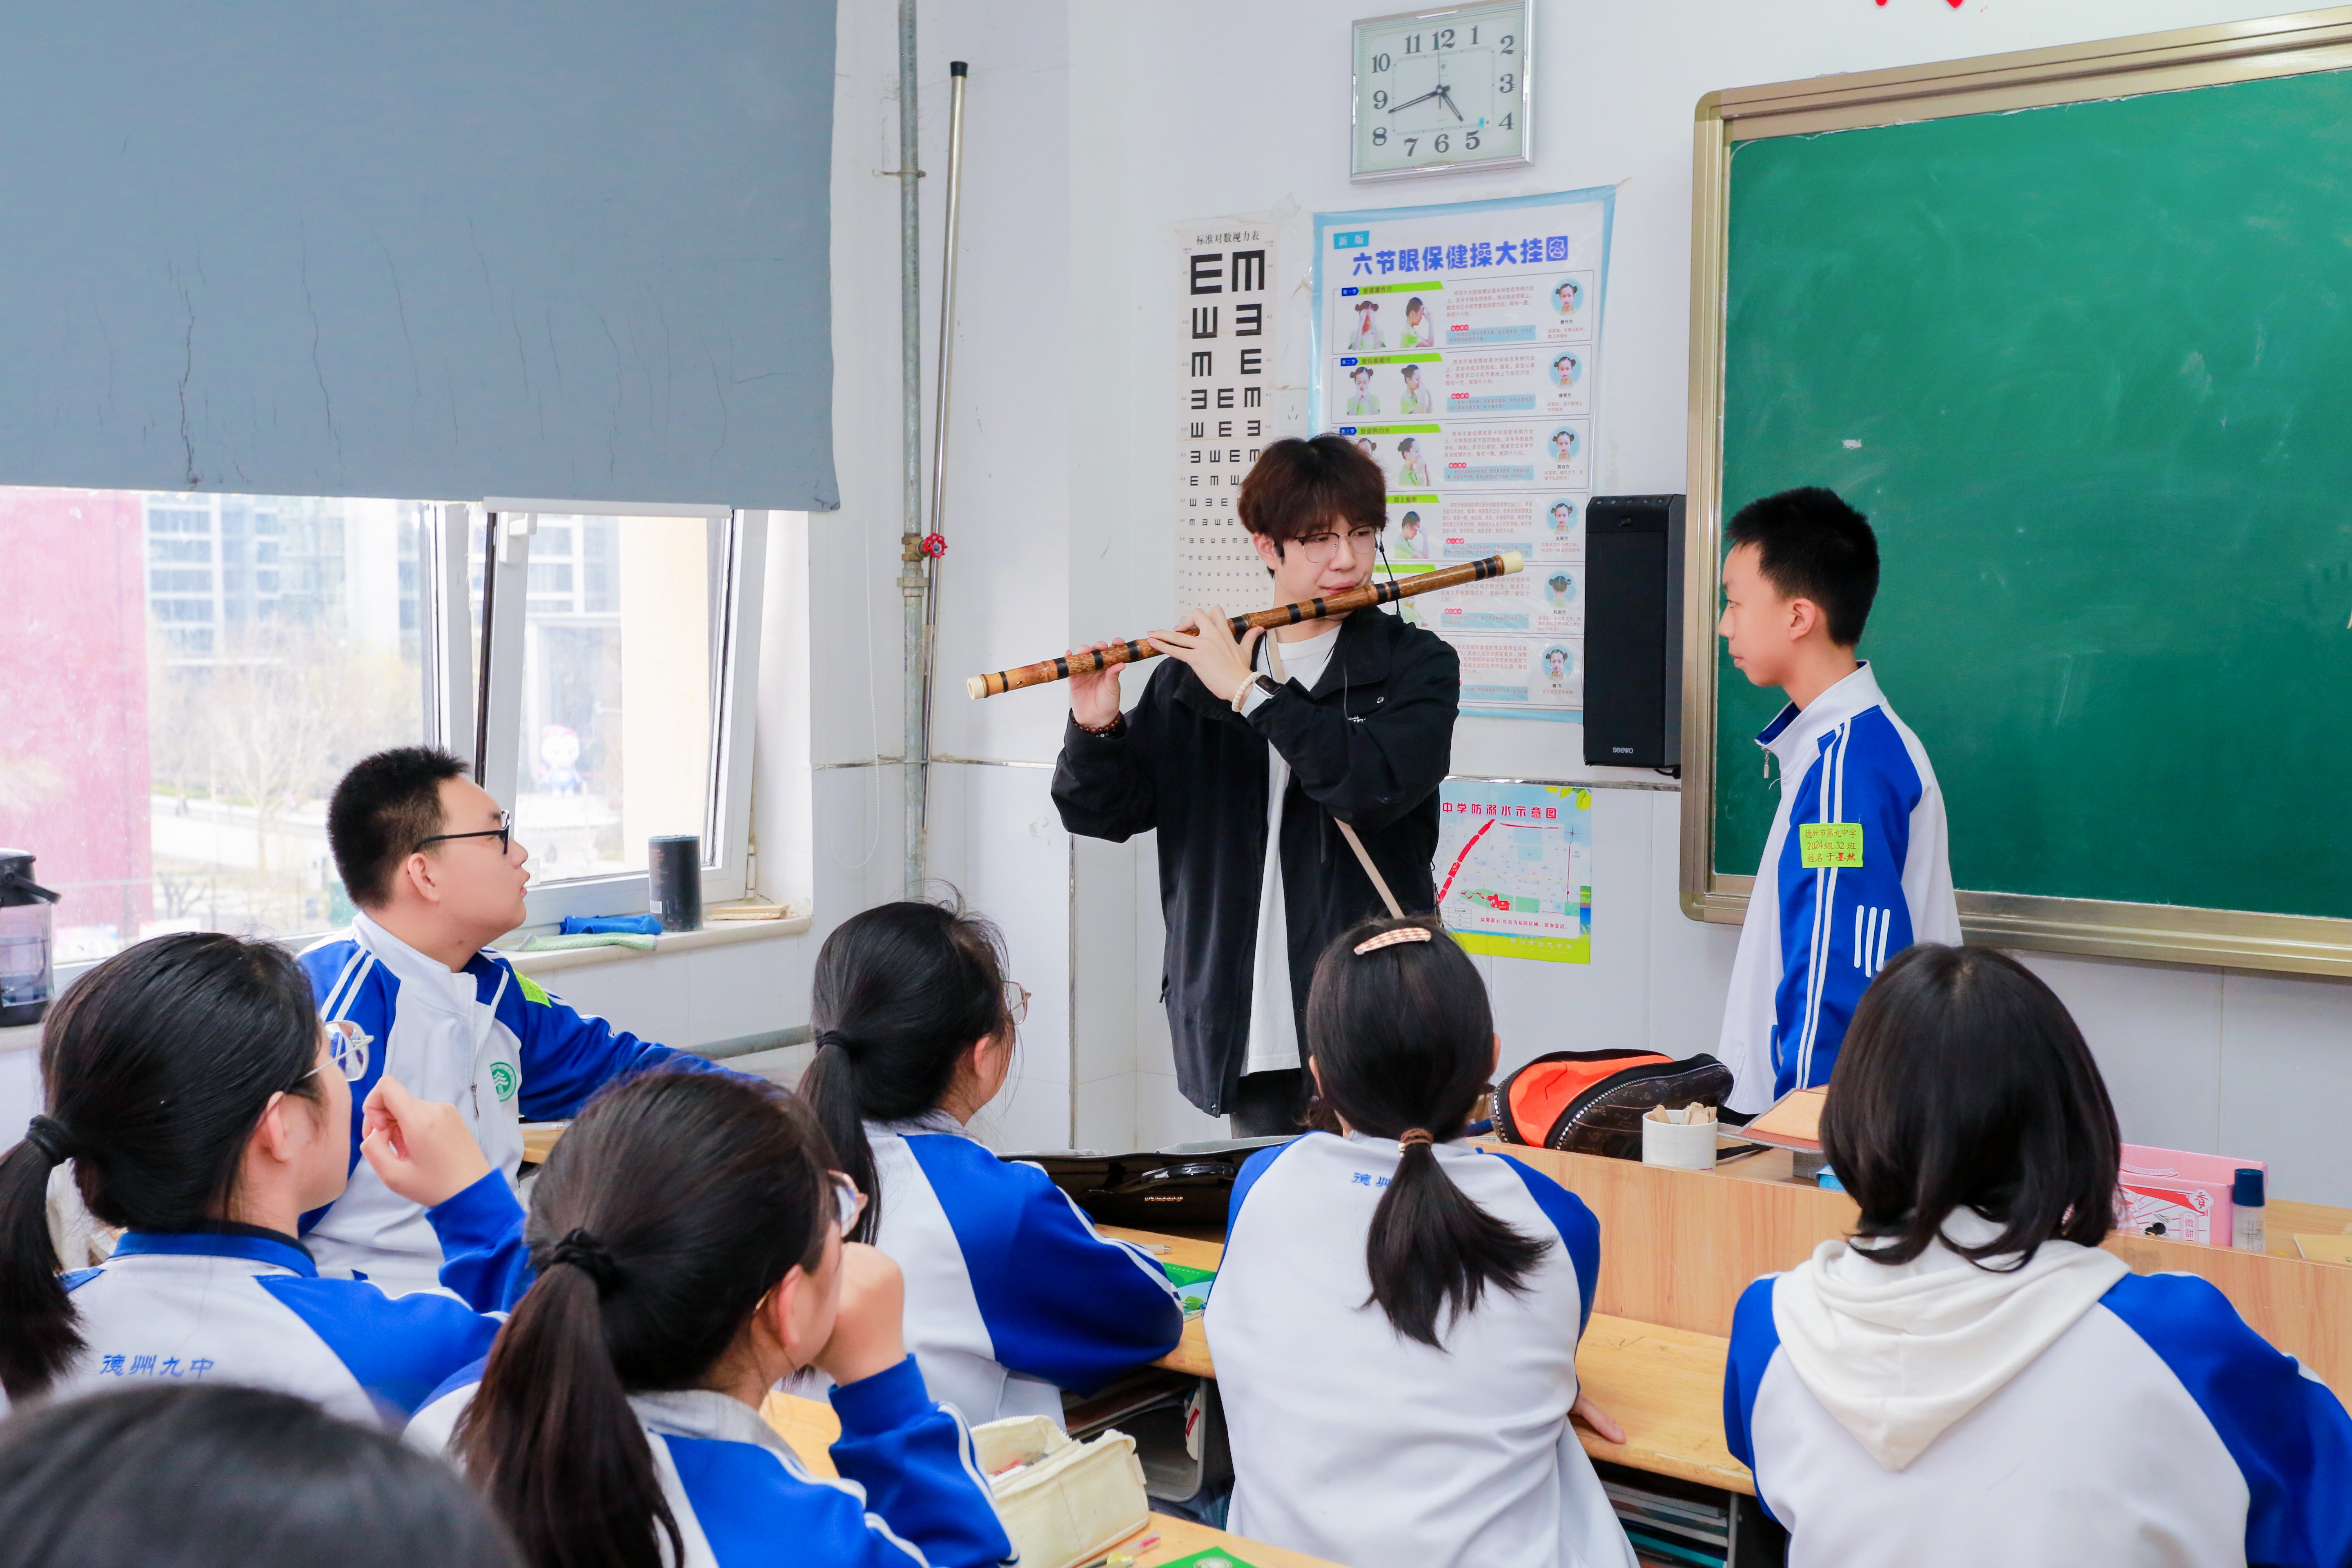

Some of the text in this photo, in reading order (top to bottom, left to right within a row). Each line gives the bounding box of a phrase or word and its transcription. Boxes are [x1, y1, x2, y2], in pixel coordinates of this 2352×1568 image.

[1405, 35, 1421, 54] 11
[1432, 29, 1455, 51] 12
[1470, 25, 1480, 45] 1
[1500, 35, 1515, 56] 2
[1372, 53, 1390, 74] 10
[1499, 74, 1515, 93] 3
[1373, 90, 1388, 109] 9
[1498, 112, 1514, 131] 4
[1372, 127, 1388, 146] 8
[1434, 134, 1449, 153] 6
[1466, 130, 1480, 149] 5
[1404, 138, 1419, 156] 7
[1197, 230, 1259, 245] 标准对数视力表
[1353, 236, 1568, 276] 六节眼保健操大挂图
[1443, 802, 1557, 819] 中学防溺水示意图
[1805, 828, 1857, 838] 德州市第九中学
[1807, 853, 1823, 862] 姓名
[2195, 1192, 2209, 1209] 香
[2185, 1219, 2194, 1242] 微甜
